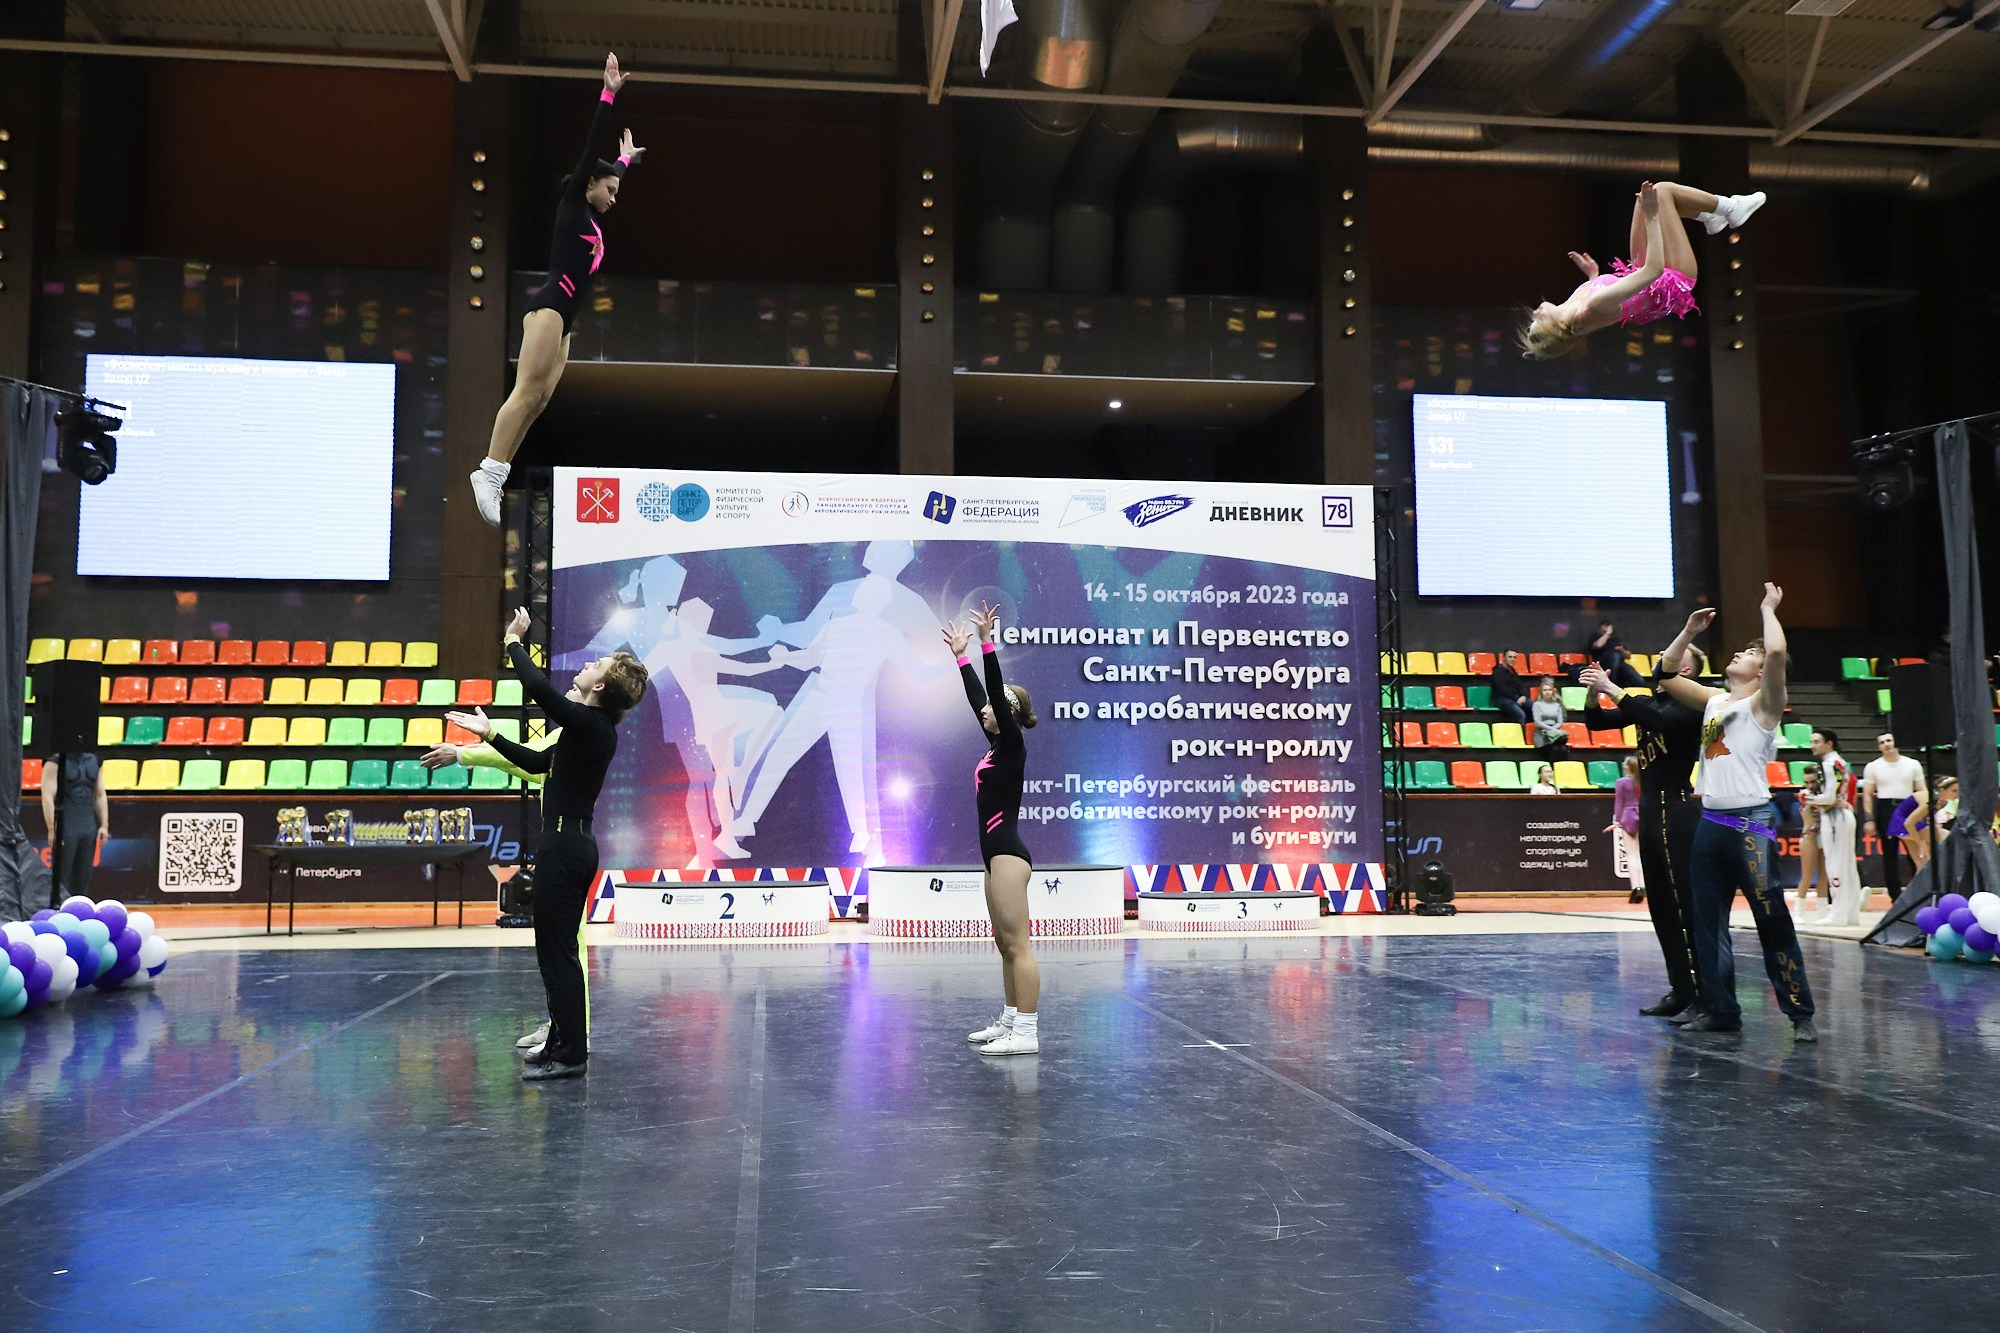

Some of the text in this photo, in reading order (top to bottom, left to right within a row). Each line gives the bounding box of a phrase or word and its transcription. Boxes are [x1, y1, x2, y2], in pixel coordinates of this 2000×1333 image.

[1428, 436, 1454, 454] 131
[715, 495, 764, 503] ФИЗИЧЕСКОЙ
[962, 506, 1039, 518] ФЕДЕРАЦИЯ
[1209, 506, 1304, 522] ДНЕВНИК
[1327, 503, 1348, 520] 78
[1084, 583, 1107, 602] 14
[1126, 584, 1148, 602] 15
[1153, 583, 1241, 609] октября
[1246, 585, 1297, 605] 2023
[1303, 589, 1349, 610] года
[1153, 627, 1168, 645] и
[1179, 621, 1349, 652] Первенство
[1083, 656, 1350, 689] Санкт-Петербурга
[1054, 696, 1352, 726] по акробатическому
[1171, 739, 1352, 763] рок-н-роллу
[1023, 774, 1355, 801] кт-Петербургский фестиваль
[1018, 800, 1356, 825] акробатическому рок-н-роллу
[1526, 821, 1580, 830] создавайте
[473, 824, 522, 861] Pla
[1233, 827, 1357, 849] и буги-вуги
[1520, 835, 1587, 844] неповторимую
[1525, 847, 1582, 857] спортивную
[295, 867, 362, 879] Петербурга
[1520, 860, 1554, 870] одежду
[1563, 860, 1589, 869] нами!
[719, 892, 736, 920] 2
[1236, 901, 1248, 920] 3
